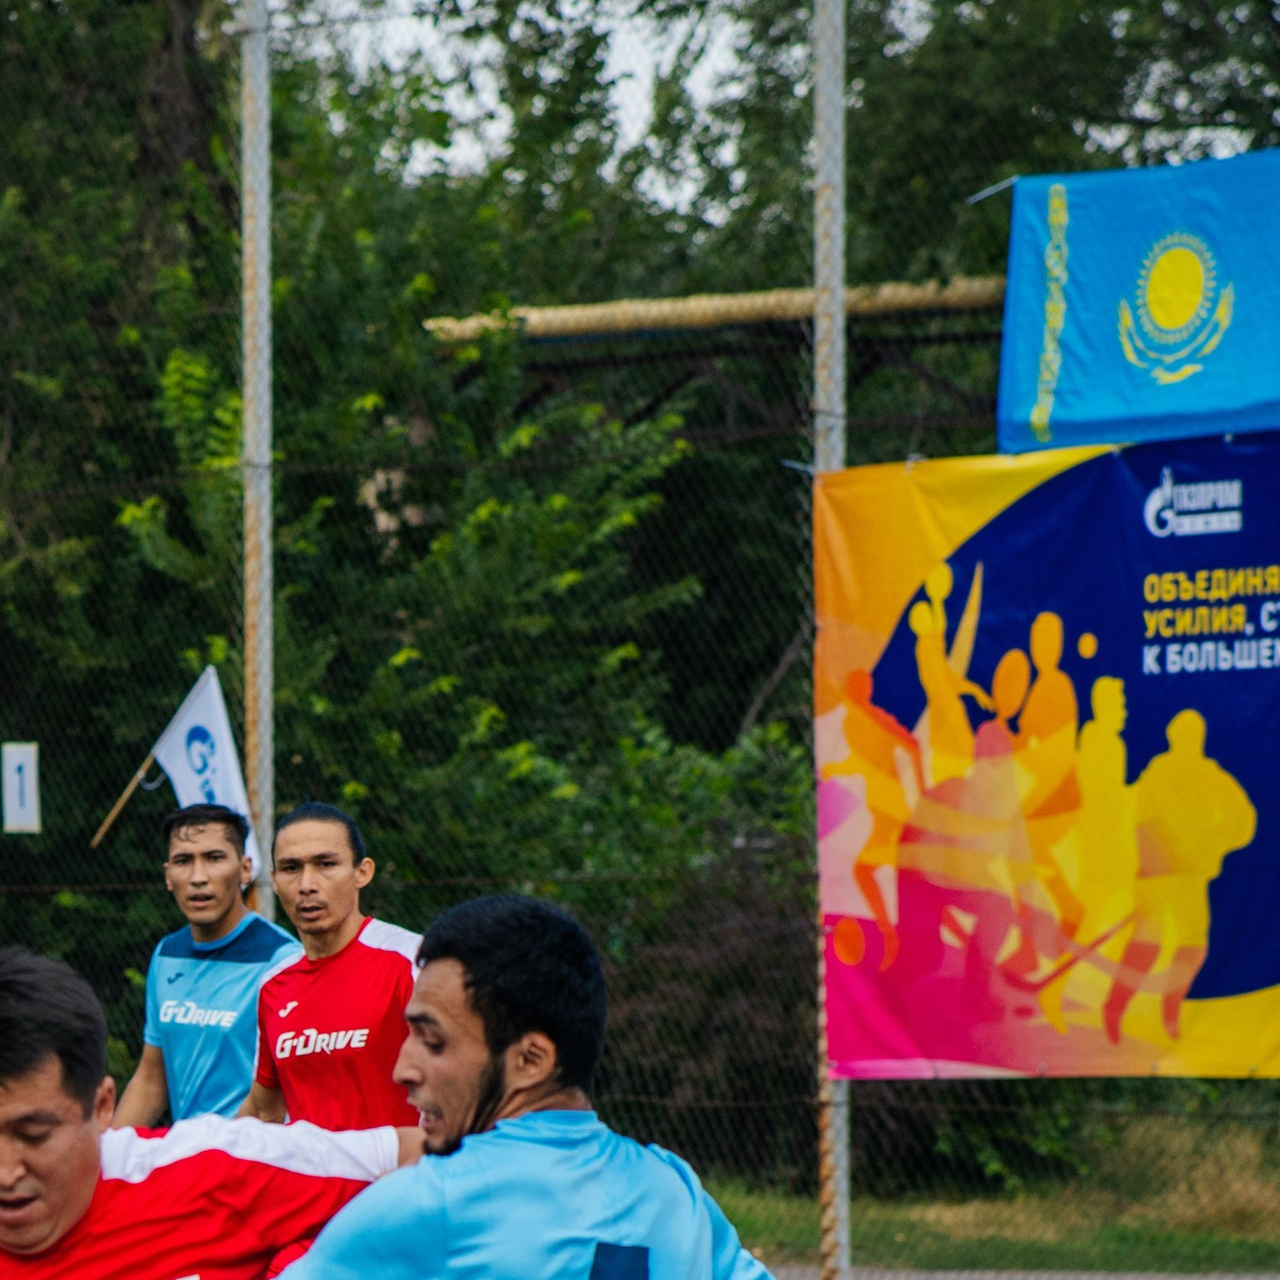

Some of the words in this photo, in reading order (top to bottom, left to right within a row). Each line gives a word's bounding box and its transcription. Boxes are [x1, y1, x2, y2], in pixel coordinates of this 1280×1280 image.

[1144, 605, 1254, 638] УСИЛИЯ,
[1261, 602, 1280, 631] С
[1143, 645, 1162, 675] К
